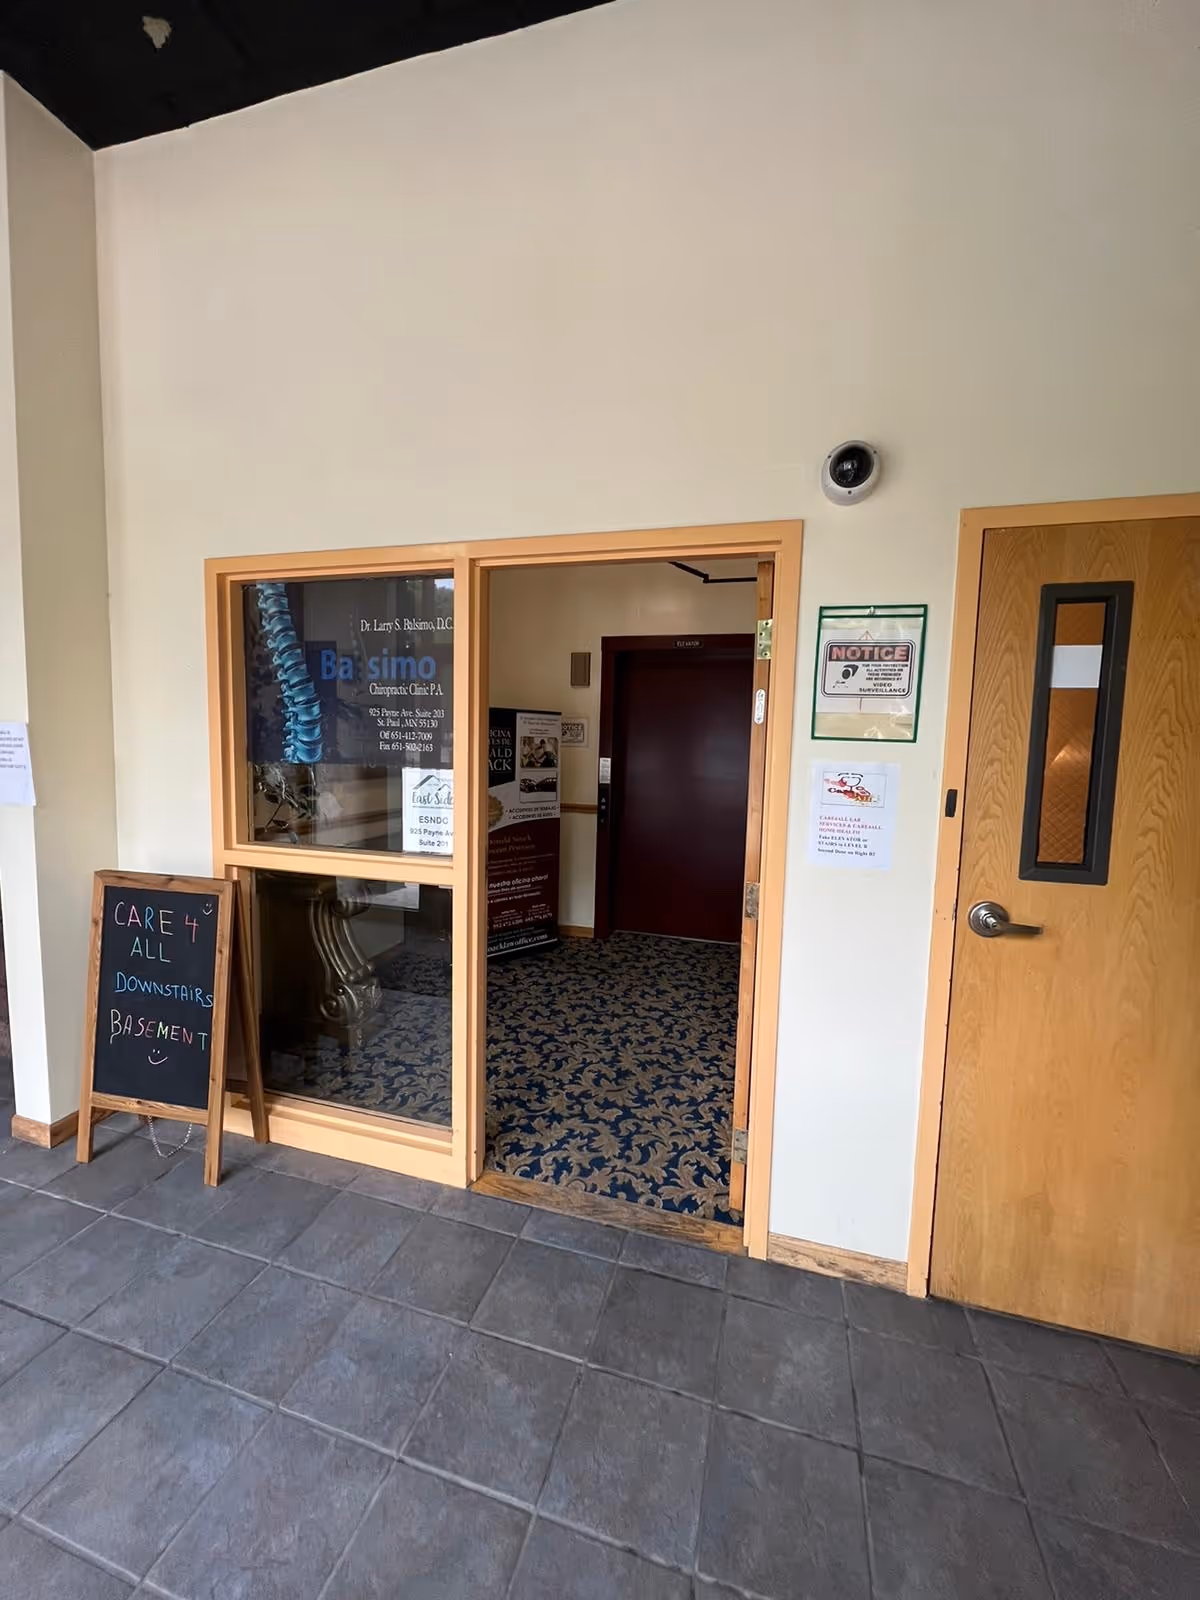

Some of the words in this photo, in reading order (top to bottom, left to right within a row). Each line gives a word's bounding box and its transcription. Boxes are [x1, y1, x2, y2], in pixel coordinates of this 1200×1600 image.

[360, 619, 372, 632] Dr.
[374, 619, 394, 634] Larry
[394, 618, 401, 631] S.
[403, 618, 435, 632] Balsimo,
[831, 646, 908, 660] NOTICE
[369, 682, 408, 697] Chiropractic
[409, 682, 430, 695] Clinic
[368, 707, 380, 716] 925
[381, 708, 399, 718] Payne
[415, 708, 431, 718] Suite
[432, 709, 445, 718] 203
[419, 719, 438, 728] 55130
[390, 730, 433, 741] 651-412-7009
[379, 741, 390, 750] Fax
[488, 758, 512, 771] ACK
[412, 791, 433, 806] East
[418, 815, 449, 824] ESNDC
[423, 828, 443, 837] Payne
[418, 839, 435, 847] Suite
[114, 901, 174, 936] CARE
[184, 913, 199, 943] 4
[130, 936, 171, 963] ALL
[110, 1009, 208, 1051] BASEMENT
